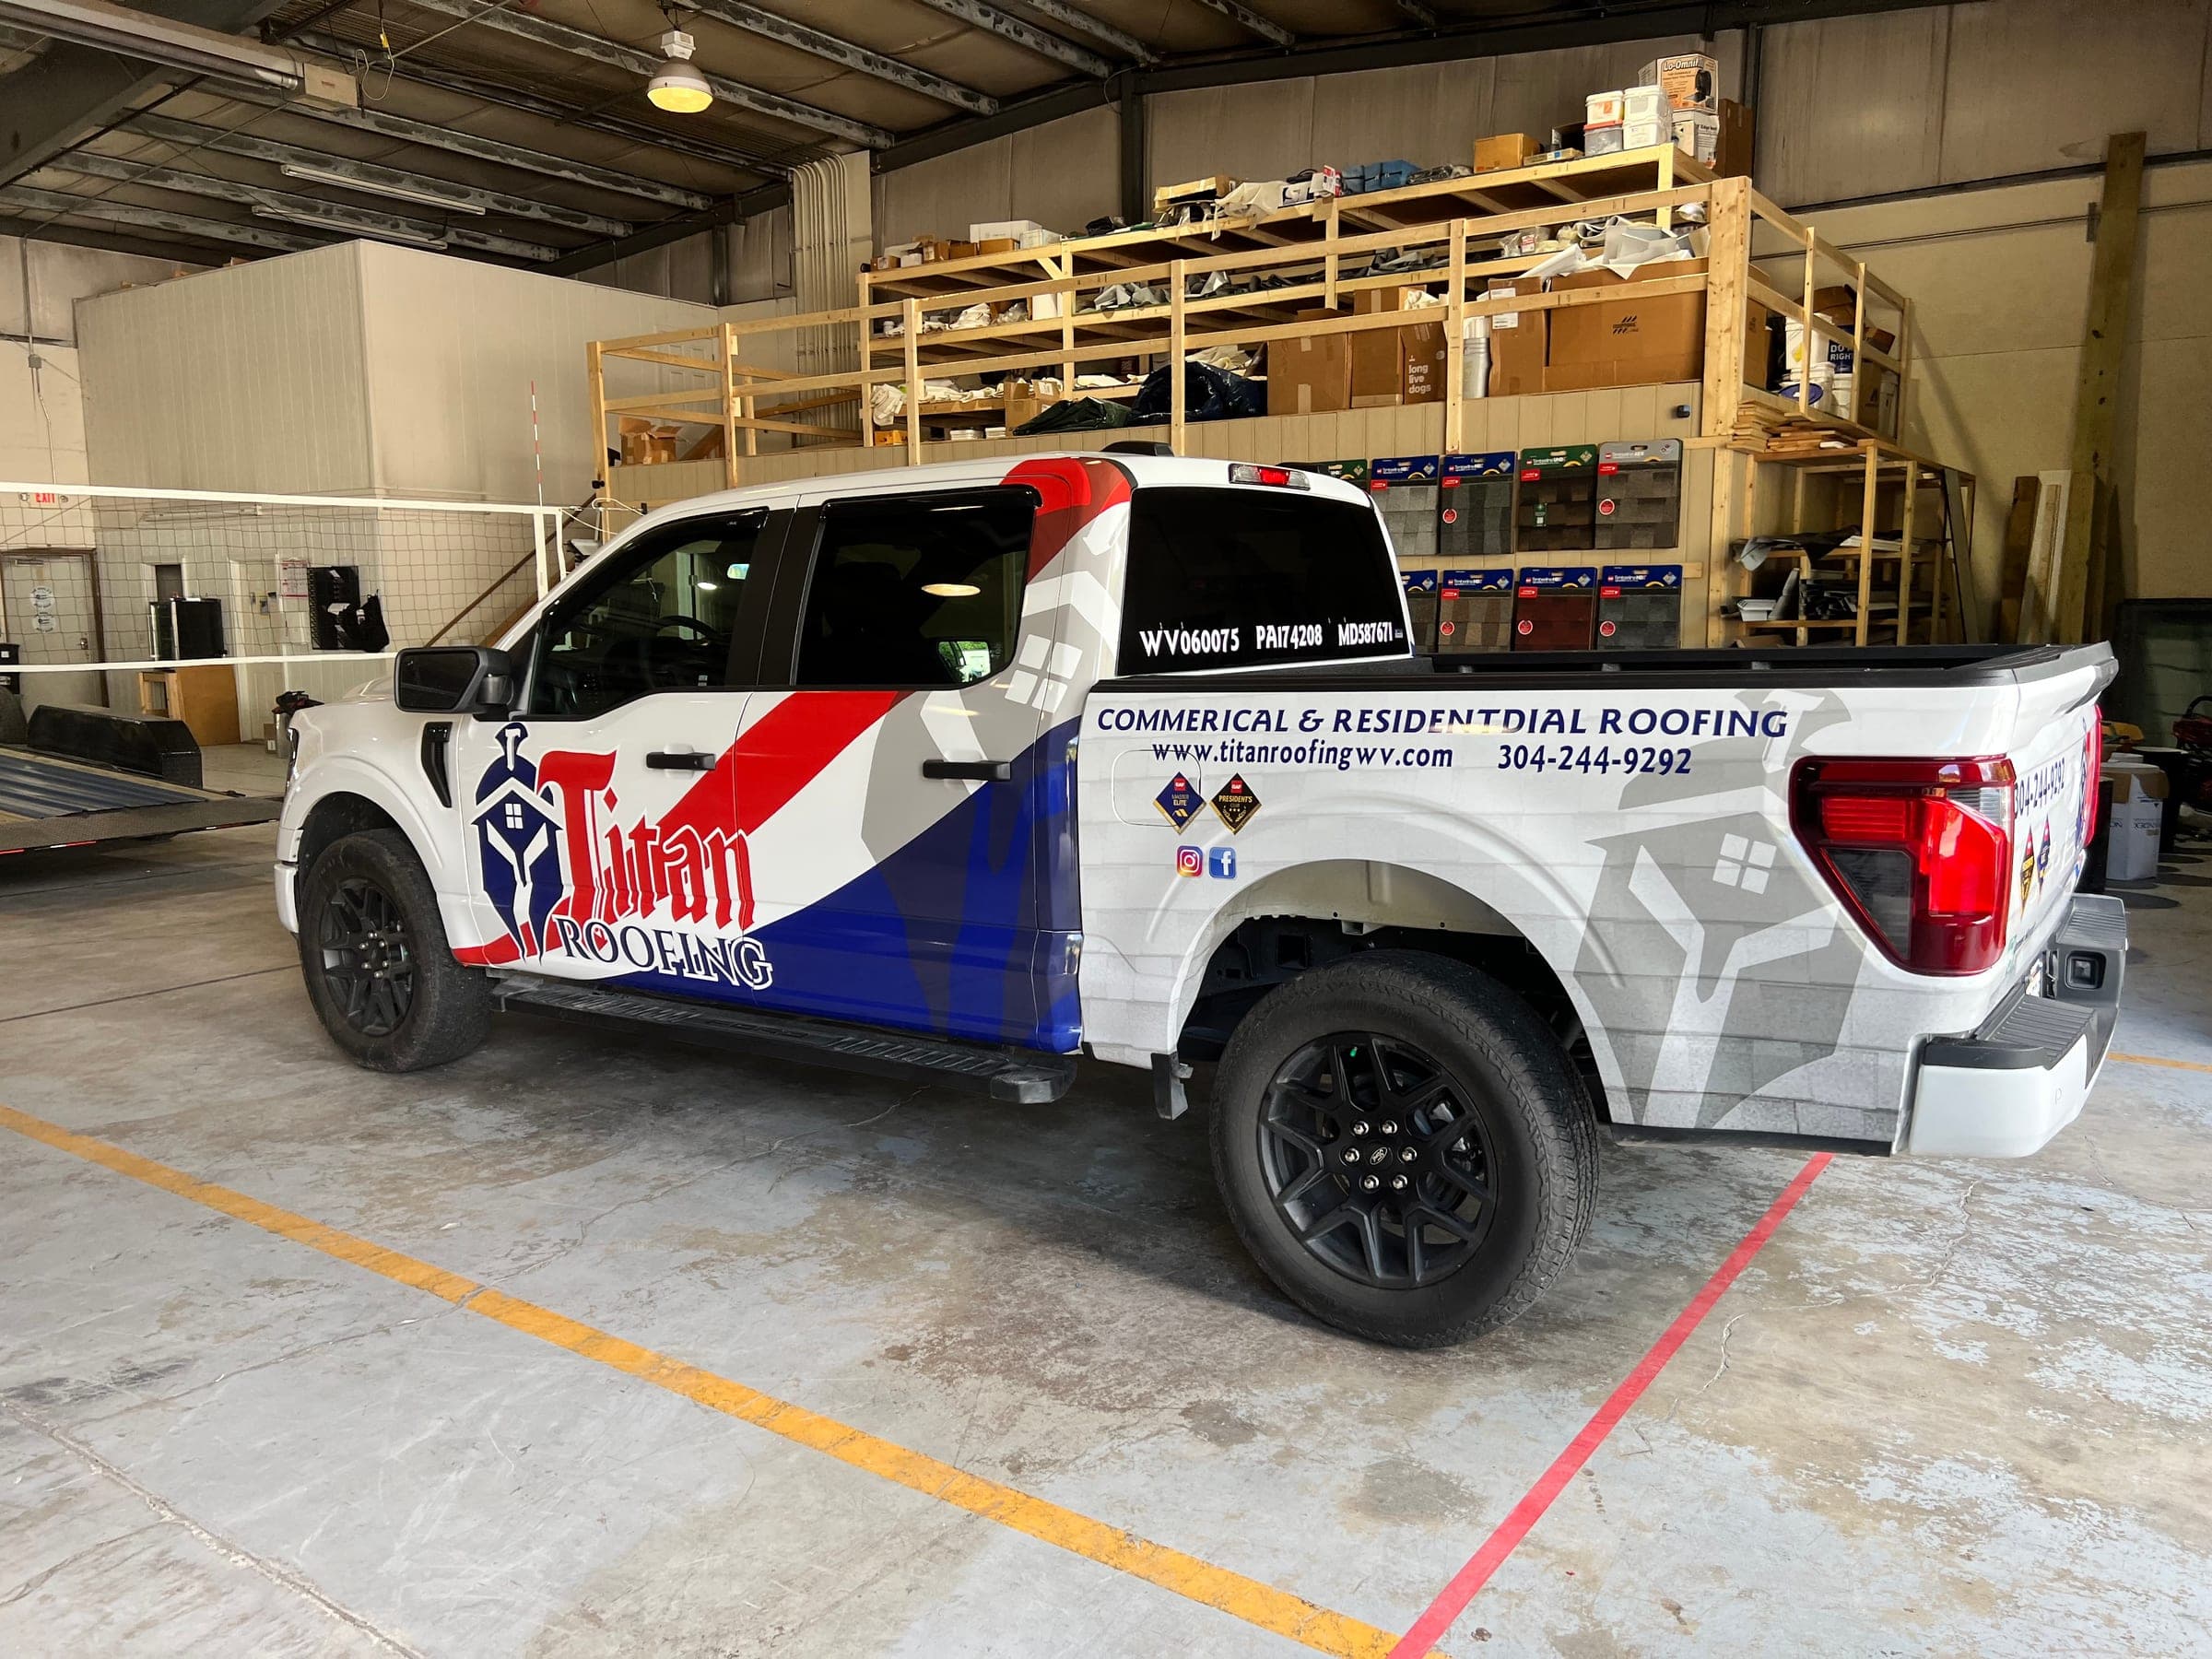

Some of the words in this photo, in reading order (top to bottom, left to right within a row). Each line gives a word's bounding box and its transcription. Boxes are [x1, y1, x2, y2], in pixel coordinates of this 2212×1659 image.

[1408, 364, 1429, 374] long
[1408, 374, 1425, 384] live
[1408, 384, 1431, 394] dogs
[35, 492, 55, 503] EXIT
[1139, 627, 1240, 657] WV060075
[1255, 623, 1323, 650] PA174208
[1338, 621, 1393, 646] MD587671
[1098, 708, 1288, 732] COMMERICAL
[1298, 708, 1324, 733] &
[1333, 707, 1587, 735] RESIDENTDIAL
[1599, 707, 1788, 738] ROOFING
[1152, 738, 1453, 771] www.titanroofingwv.com
[1498, 744, 1692, 776] 304-244-9292
[2015, 757, 2065, 818] 304-244-9292
[536, 748, 756, 933] Titan
[555, 916, 773, 990] ROOFING
